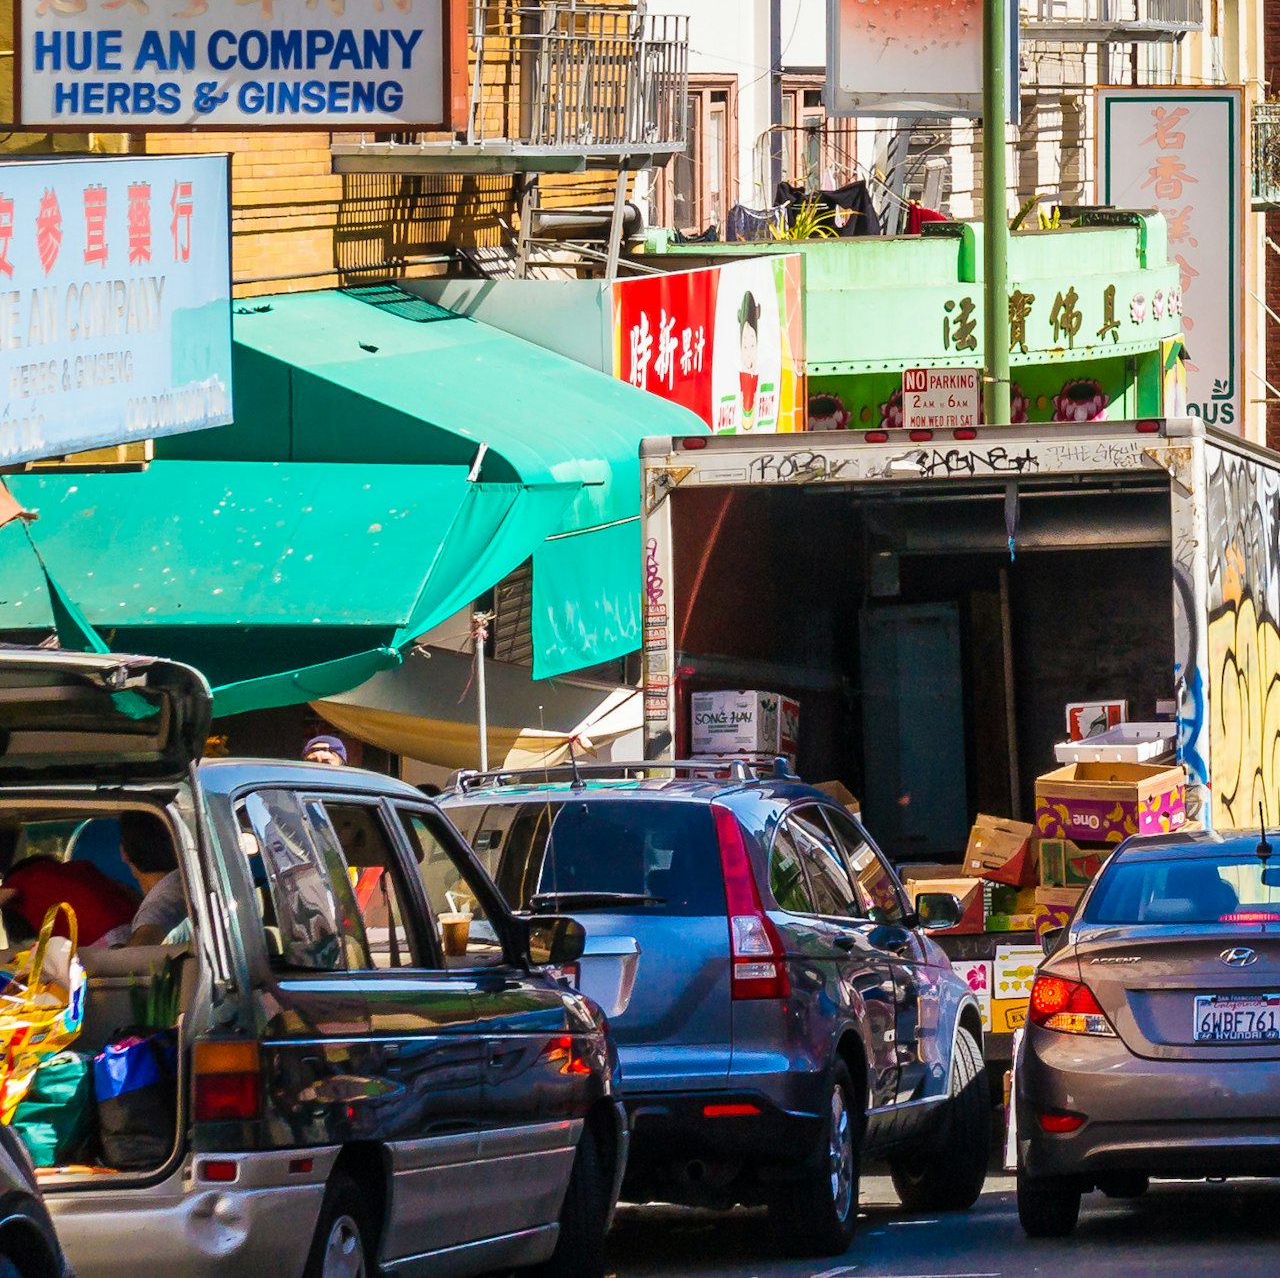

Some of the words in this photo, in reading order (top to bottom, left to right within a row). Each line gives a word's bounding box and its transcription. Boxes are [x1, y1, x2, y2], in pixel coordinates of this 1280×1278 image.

[33, 30, 122, 72] HUE
[130, 30, 196, 72] AN
[206, 28, 424, 72] COMPANY
[53, 81, 181, 116] HERBS
[193, 81, 229, 115] &
[237, 81, 404, 115] GINSENG
[905, 371, 926, 392] NO
[930, 374, 974, 390] PARKING
[694, 712, 728, 725] SONG
[1072, 814, 1100, 830] One
[1090, 956, 1142, 965] ACCENT
[1200, 1011, 1277, 1032] 6WBF761
[1215, 1032, 1263, 1040] HYUNDAI
